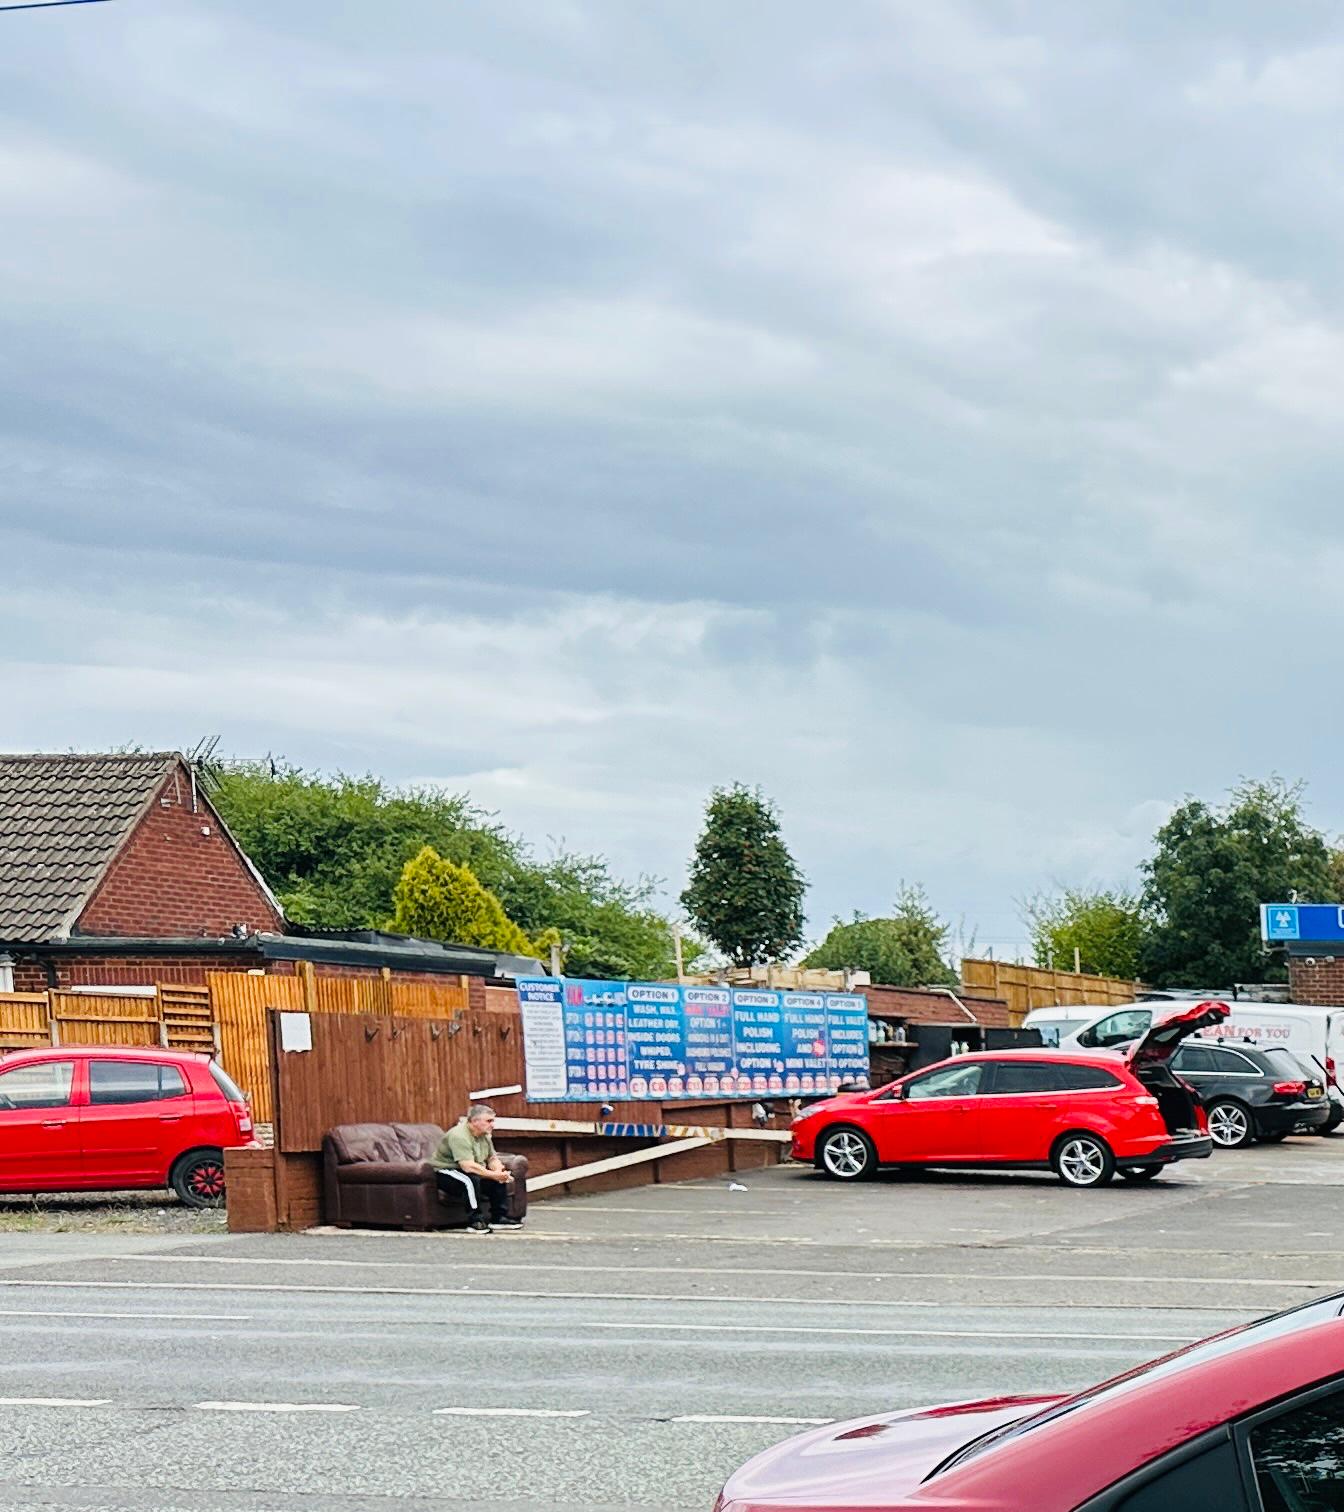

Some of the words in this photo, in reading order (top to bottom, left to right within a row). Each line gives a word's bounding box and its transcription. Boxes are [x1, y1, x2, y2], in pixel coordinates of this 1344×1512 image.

[631, 989, 668, 999] OPTION
[687, 991, 719, 1001] OPTION
[1266, 1028, 1291, 1038] YOU
